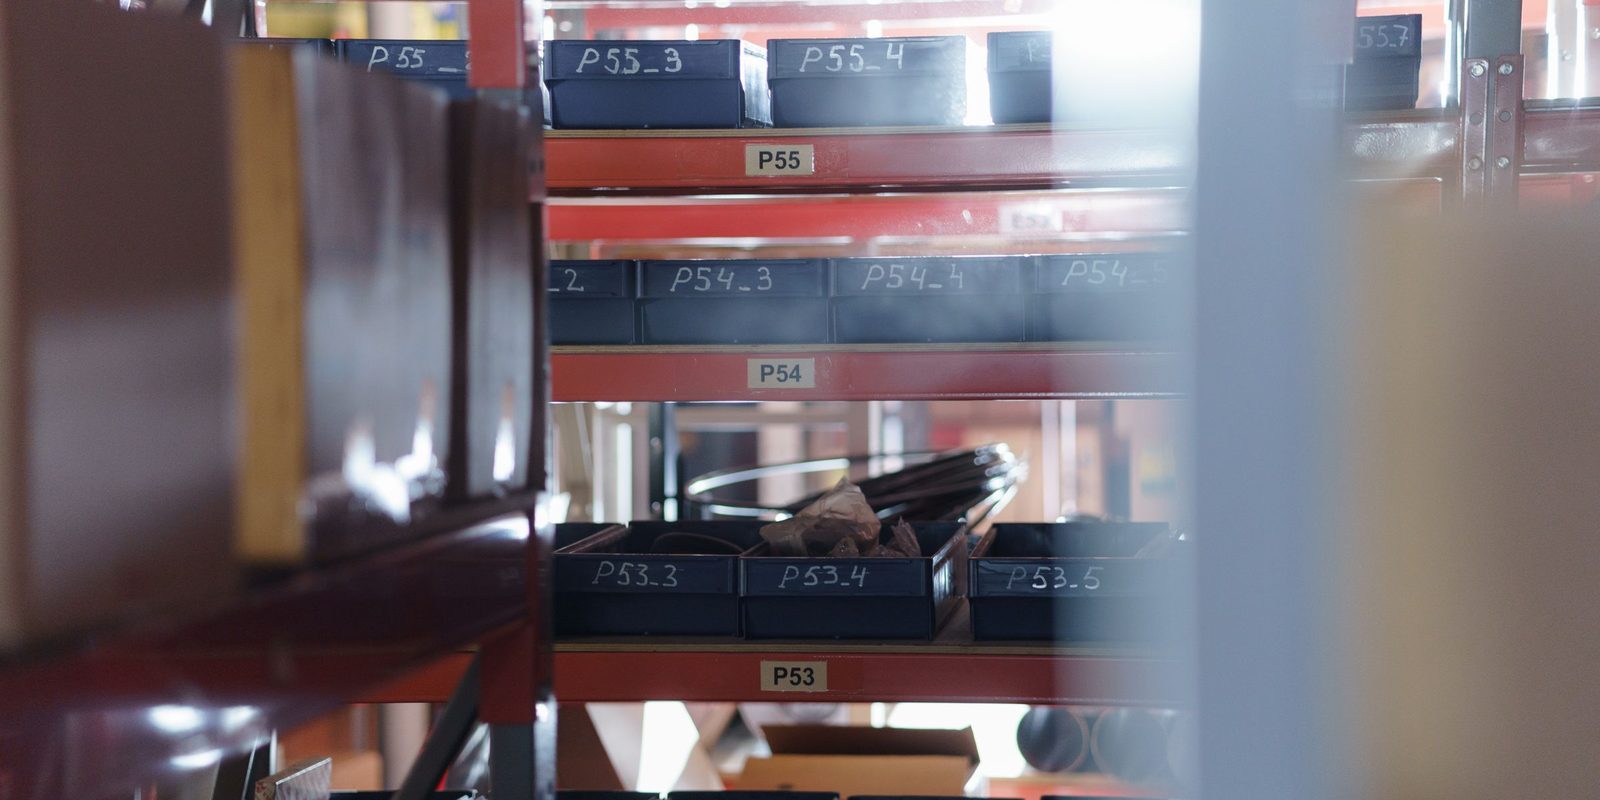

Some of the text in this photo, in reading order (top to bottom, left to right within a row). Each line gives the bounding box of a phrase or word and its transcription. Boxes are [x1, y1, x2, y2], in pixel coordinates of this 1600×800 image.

[575, 48, 682, 74] P55_3
[799, 43, 904, 73] P55_4
[758, 151, 801, 170] P55
[669, 266, 772, 292] P54_3
[861, 263, 963, 290] P54_4
[759, 364, 802, 383] P54
[591, 560, 680, 588] P53_3
[778, 565, 868, 588] P53_4
[773, 667, 815, 686] P53
